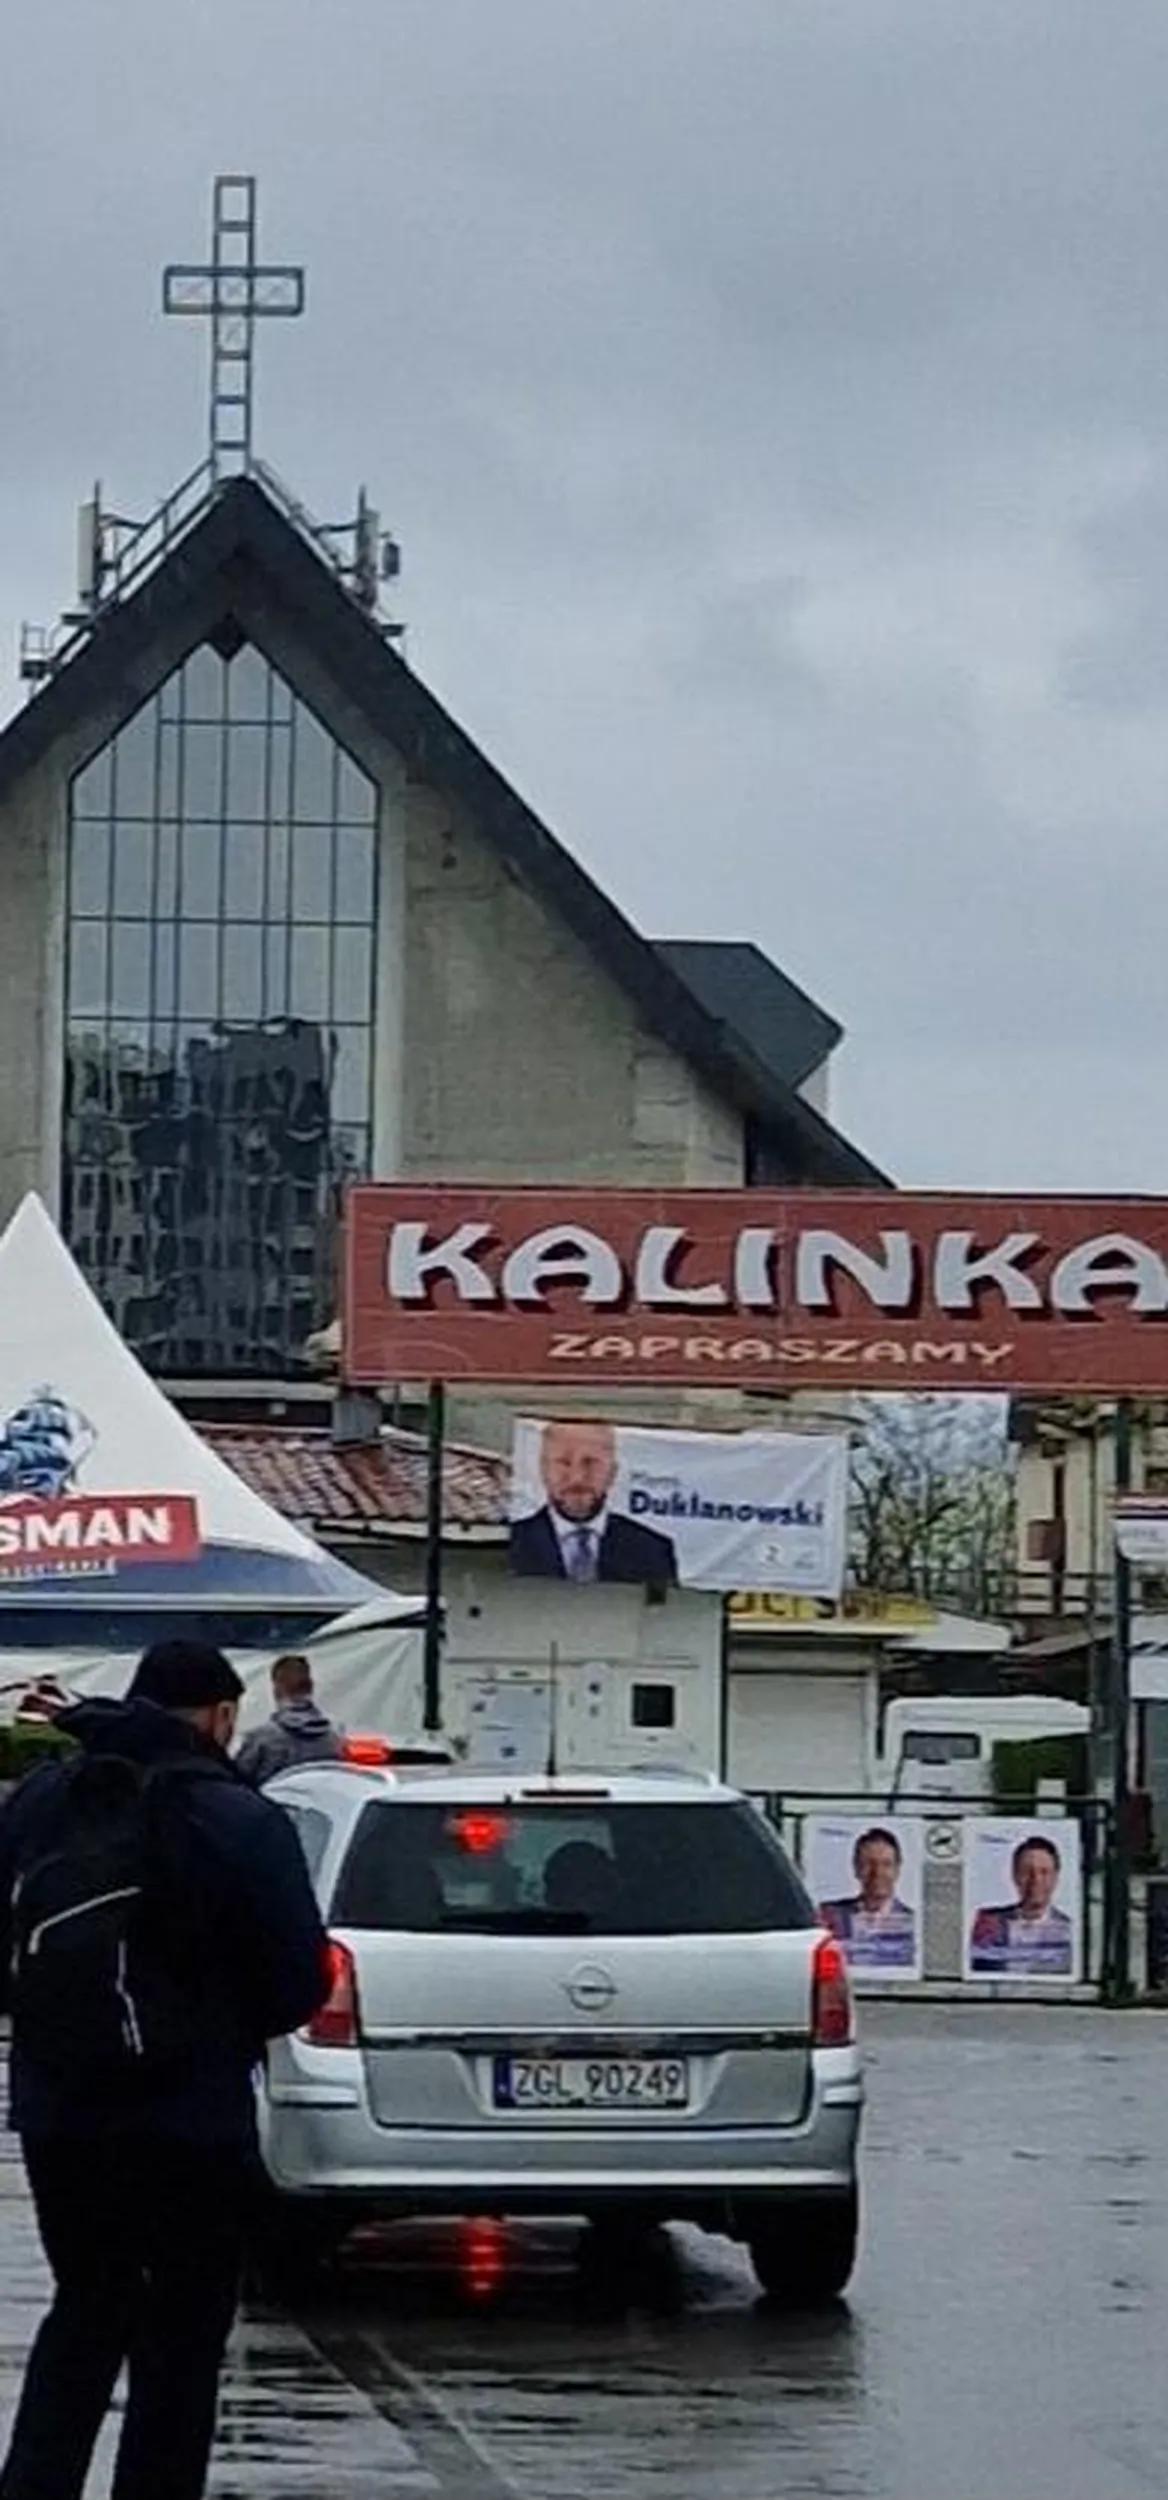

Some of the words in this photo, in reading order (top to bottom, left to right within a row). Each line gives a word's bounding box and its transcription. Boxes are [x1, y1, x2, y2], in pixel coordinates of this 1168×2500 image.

[387, 1221, 1168, 1311] KALINKA
[547, 1332, 1016, 1366] ZAPRASZAMY
[0, 1507, 172, 1555] SMAN
[515, 2063, 572, 2097] ZGL
[586, 2063, 681, 2096] 90249
